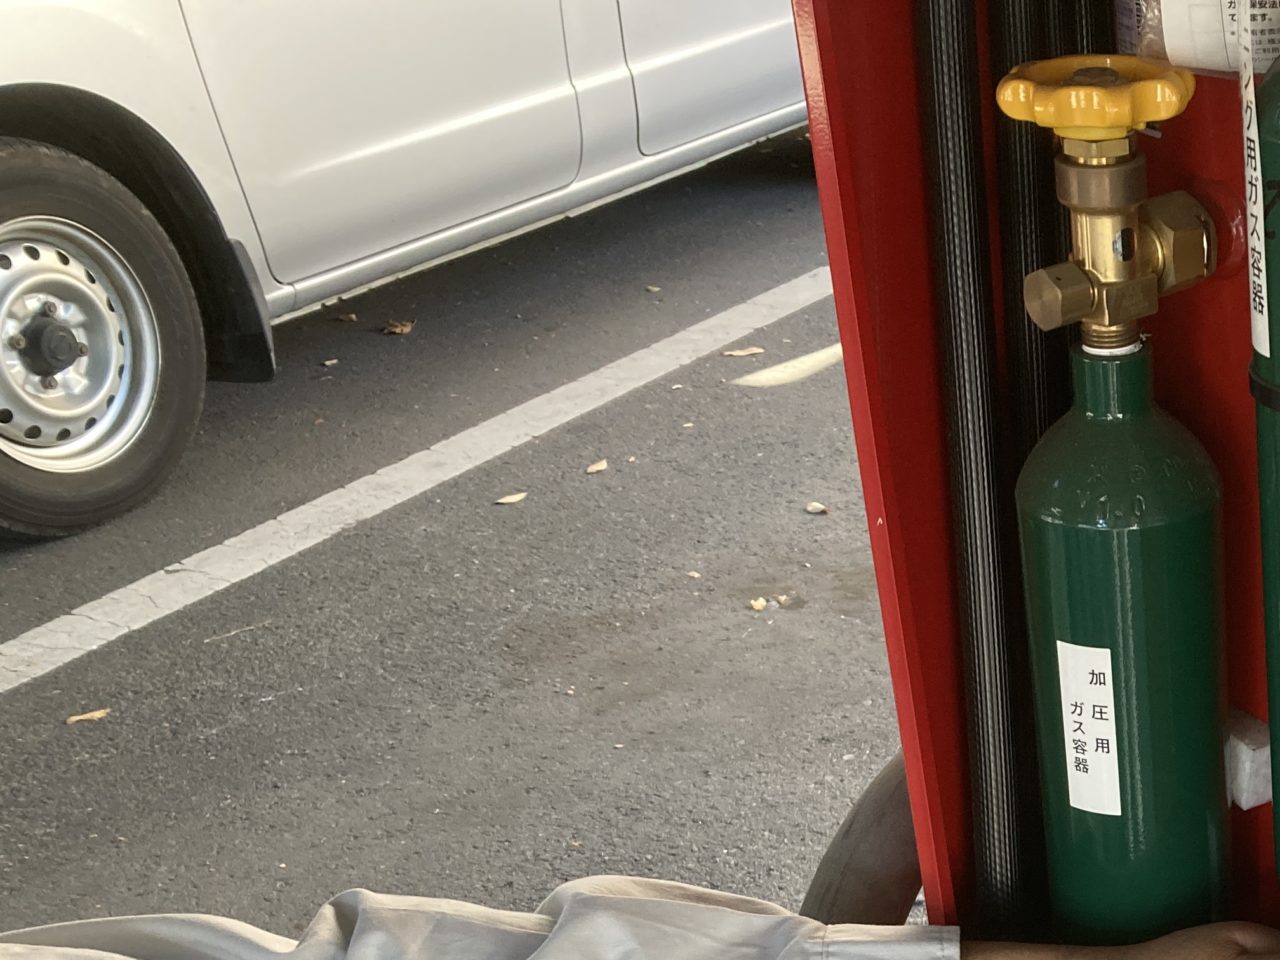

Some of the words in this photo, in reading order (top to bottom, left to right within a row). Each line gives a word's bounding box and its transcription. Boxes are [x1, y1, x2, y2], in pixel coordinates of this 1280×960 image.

[1070, 701, 1089, 774] ガス容器
[1089, 669, 1111, 754] 加圧用
